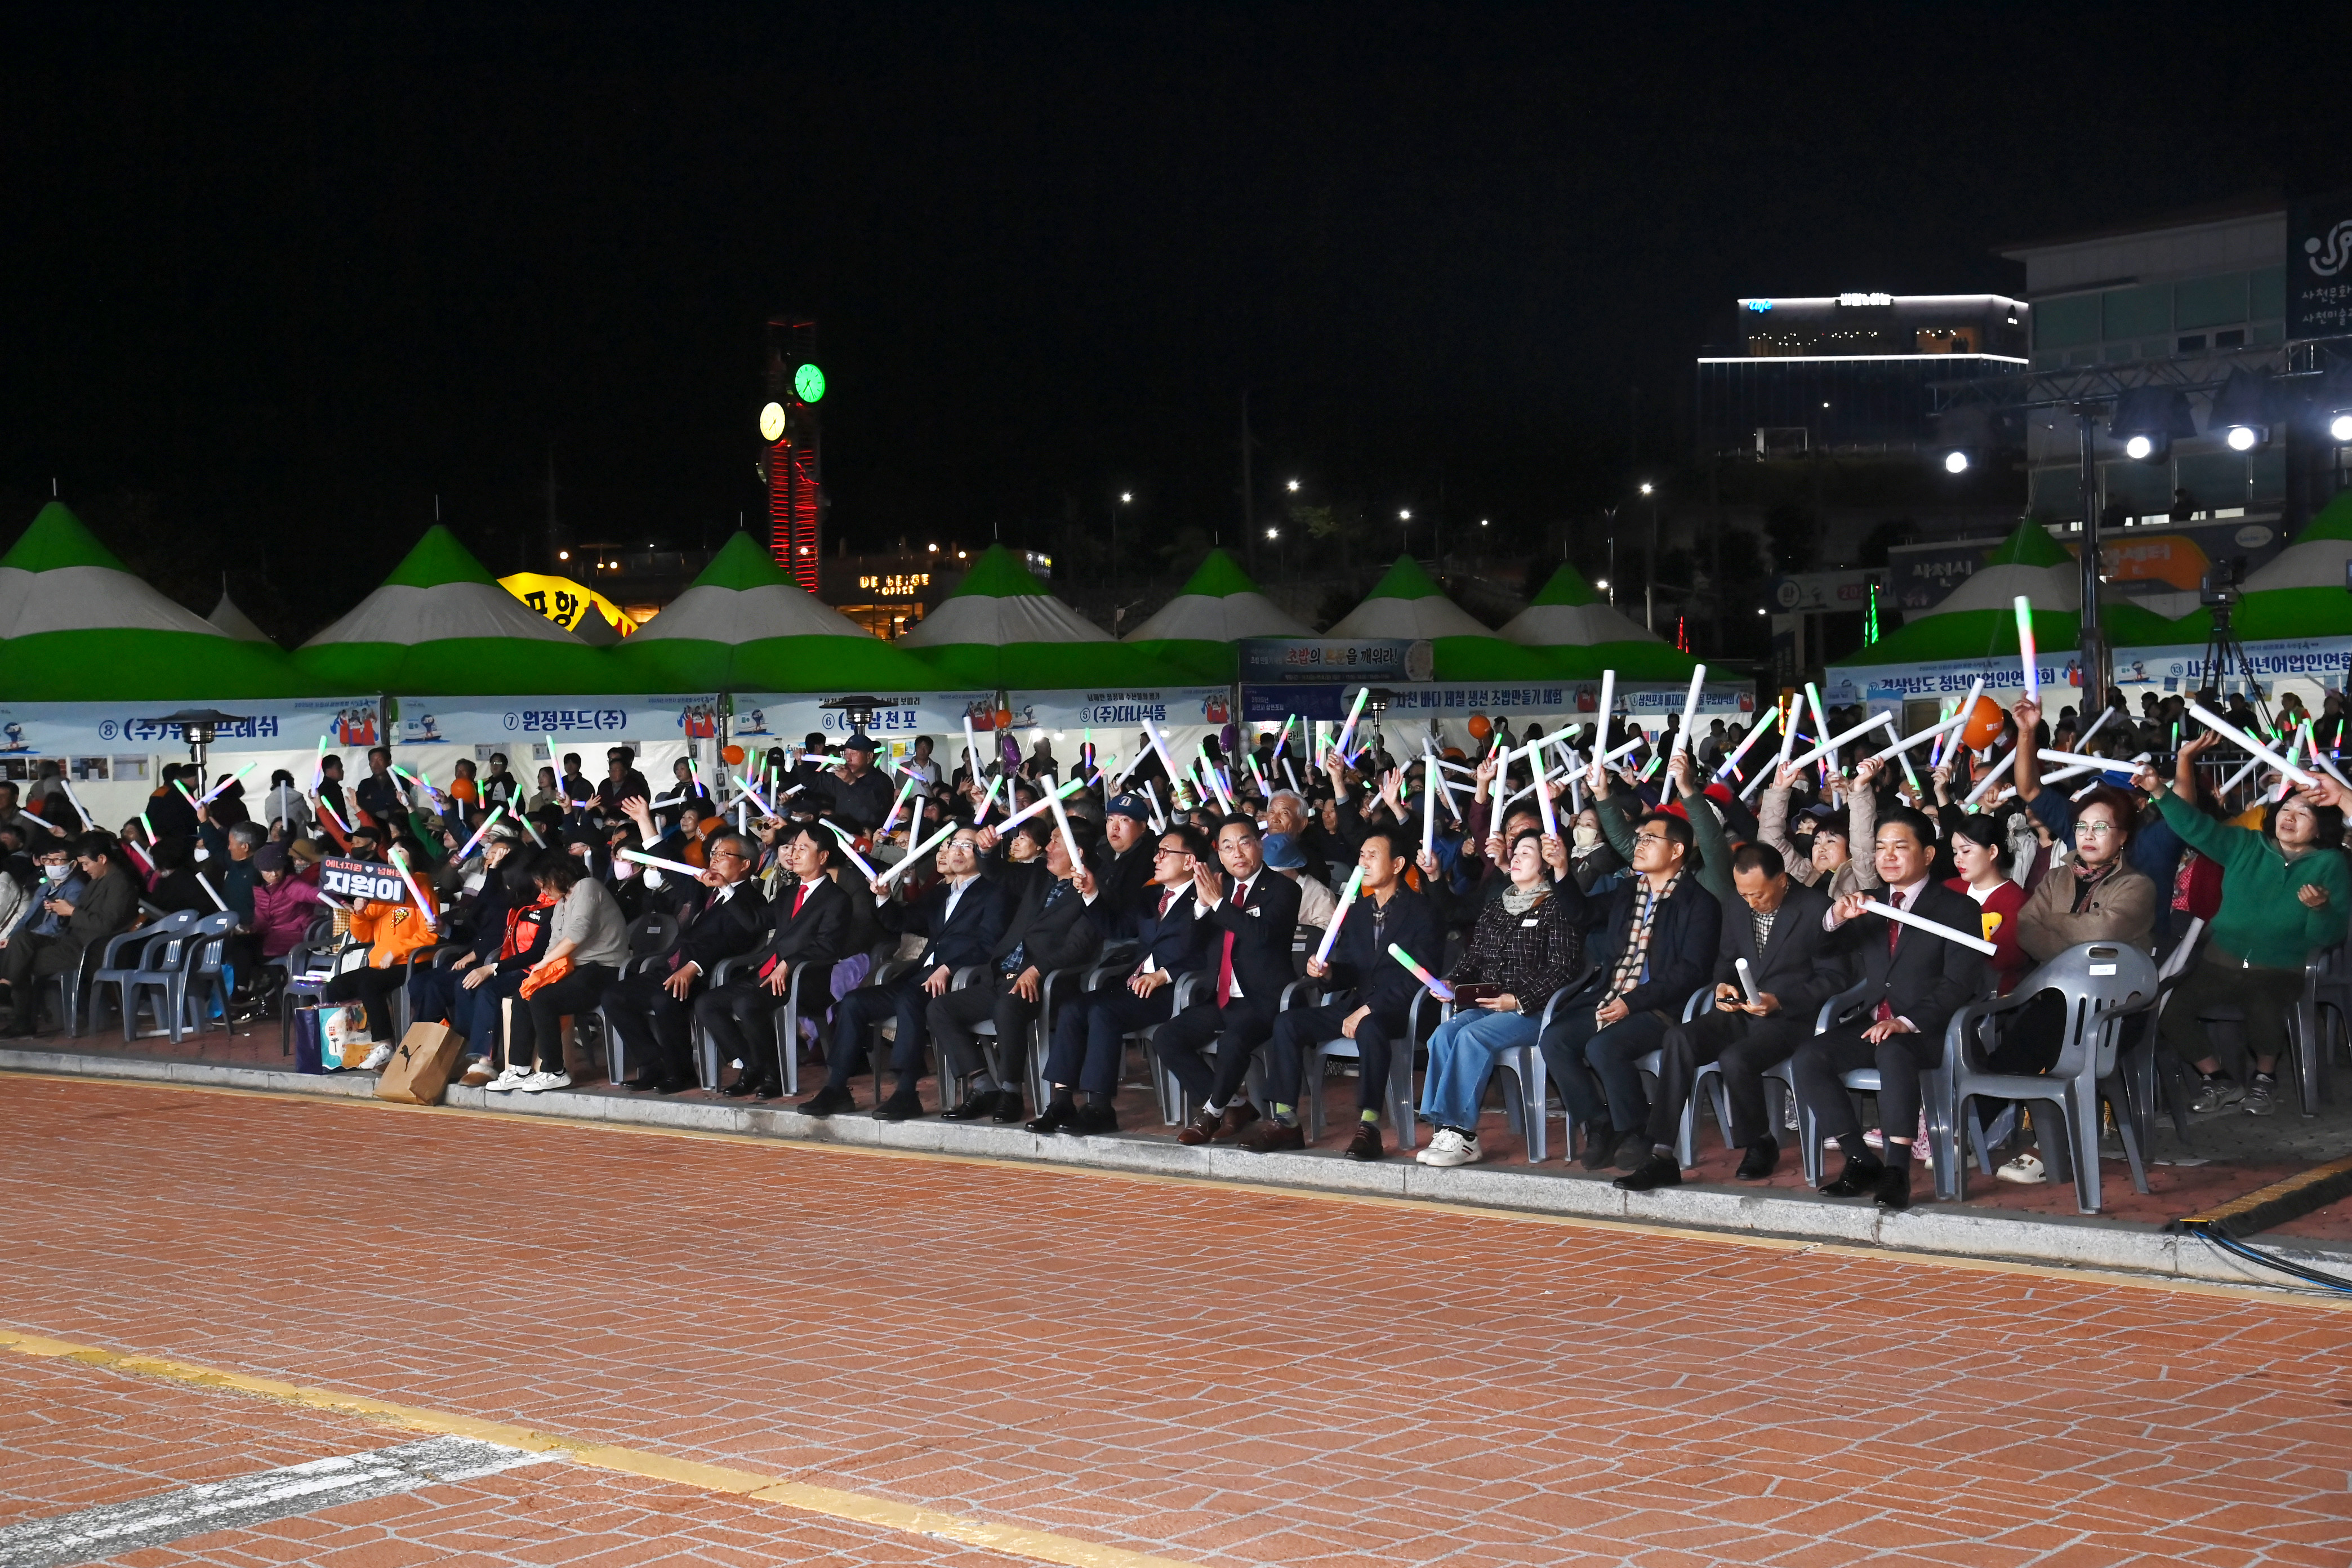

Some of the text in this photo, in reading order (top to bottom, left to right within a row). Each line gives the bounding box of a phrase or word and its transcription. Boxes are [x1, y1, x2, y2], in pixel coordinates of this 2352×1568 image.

[859, 576, 878, 588] DE
[1912, 560, 1971, 587] 사천시
[1286, 647, 1321, 665] 초밥의
[1361, 647, 1398, 665] 깨워라!
[1939, 668, 2055, 692] 청년어업인연회
[901, 697, 920, 706] 보따리
[1444, 691, 1465, 707] 제철
[1468, 690, 1489, 707] 생선
[1543, 688, 1562, 705] 체험
[522, 710, 627, 731] 원정푸드(주)
[1093, 705, 1166, 723] (주)다나식품
[325, 859, 363, 872] 에너지원
[323, 871, 402, 901] 지원이
